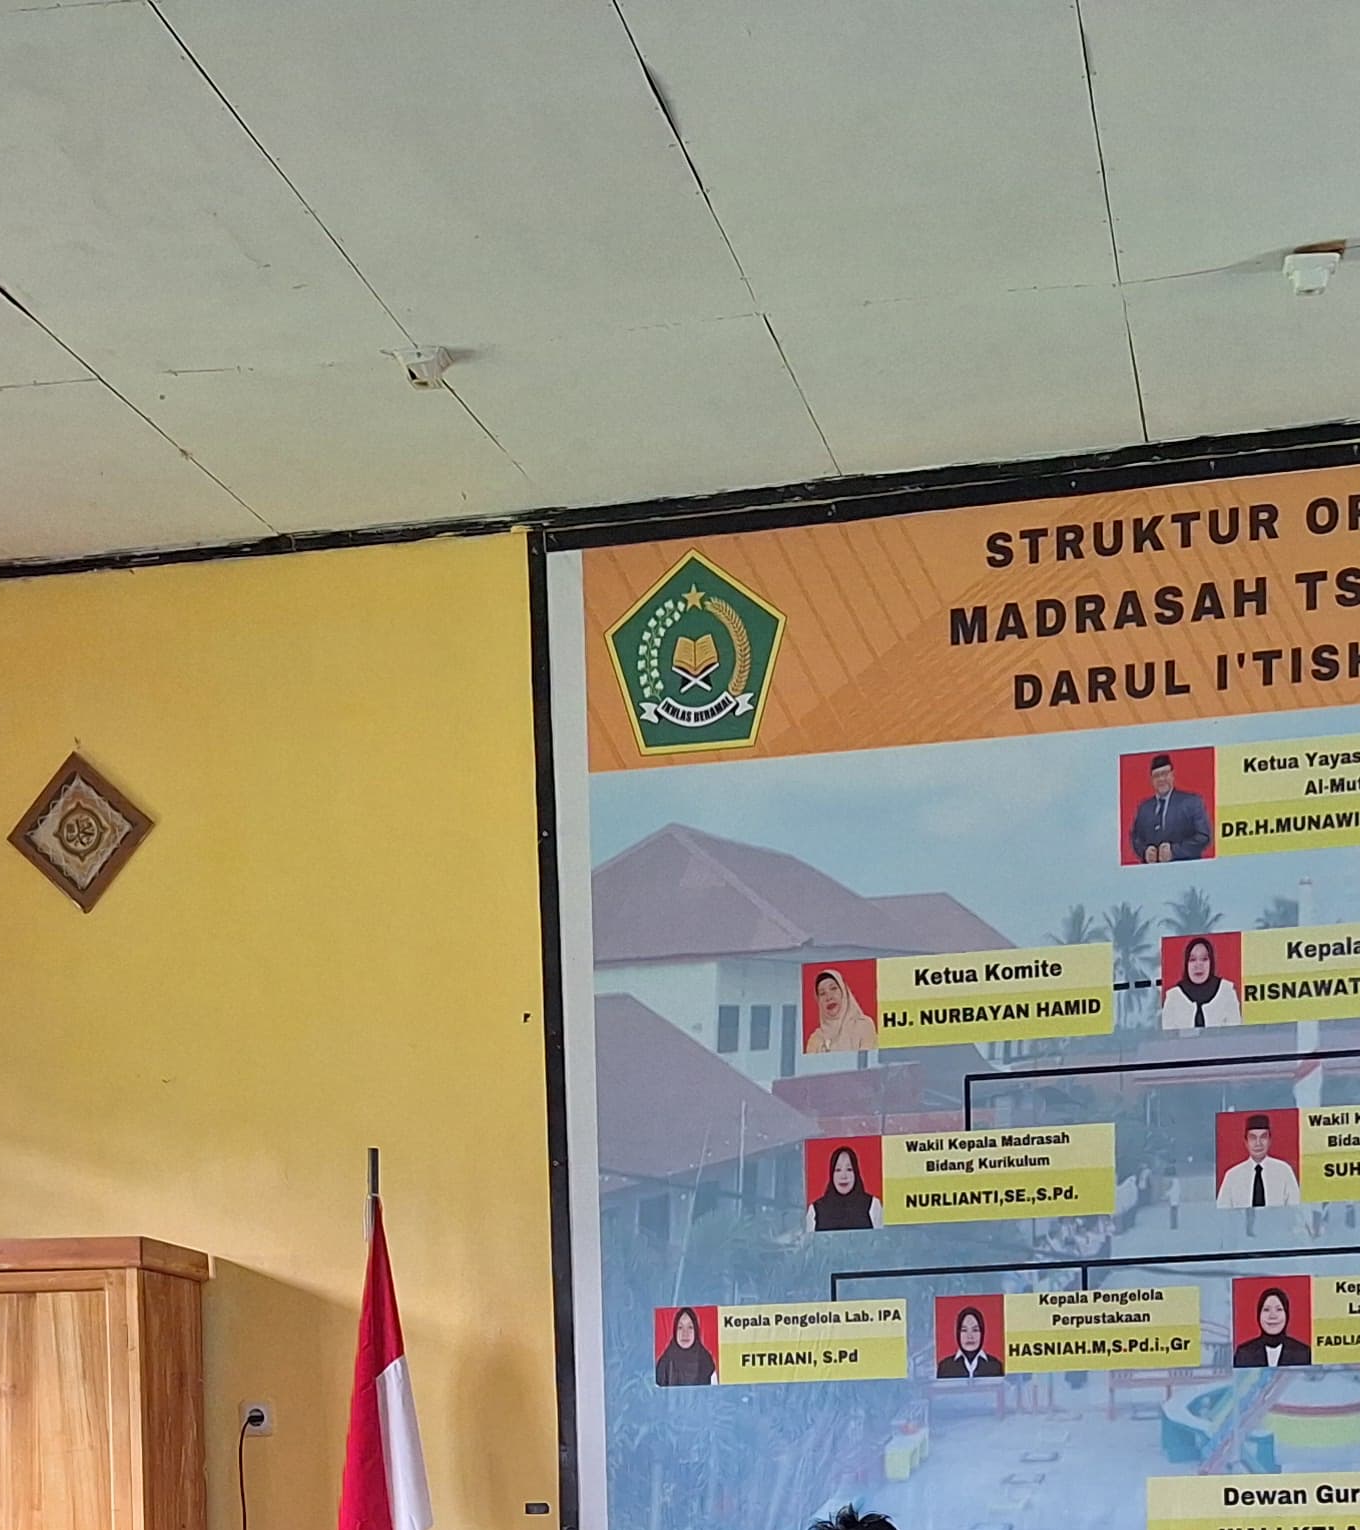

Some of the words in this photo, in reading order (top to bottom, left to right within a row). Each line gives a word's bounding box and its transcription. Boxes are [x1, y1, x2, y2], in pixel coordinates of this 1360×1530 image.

[986, 503, 1279, 569] STRUKTUR
[949, 576, 1267, 646] MADRASAH
[1014, 659, 1191, 710] DARUL
[1243, 755, 1300, 773] Ketua
[914, 967, 979, 987] Ketua
[985, 959, 1063, 982] Komite
[883, 1011, 914, 1028] HJ.
[920, 1003, 1030, 1026] NURBAYAN
[1036, 998, 1101, 1018] HAMID
[1308, 1112, 1350, 1127] Wakil
[905, 1138, 944, 1153] Wakil
[948, 1135, 998, 1153] Kepala
[1001, 1131, 1070, 1148] Madrasah
[925, 1159, 975, 1174] Bidang
[978, 1154, 1050, 1170] Kurikulum
[1039, 1291, 1089, 1308] Kepala
[1092, 1288, 1164, 1306] Pengelola
[723, 1314, 771, 1330] Kepala
[774, 1311, 841, 1328] Pengelola
[844, 1309, 874, 1323] Lab.
[878, 1309, 902, 1322] IPA
[1052, 1311, 1151, 1329] Perpustakaan
[741, 1351, 818, 1368] FITRIANI,
[822, 1348, 858, 1364] S.Pd
[1223, 1487, 1307, 1506] Dewan
